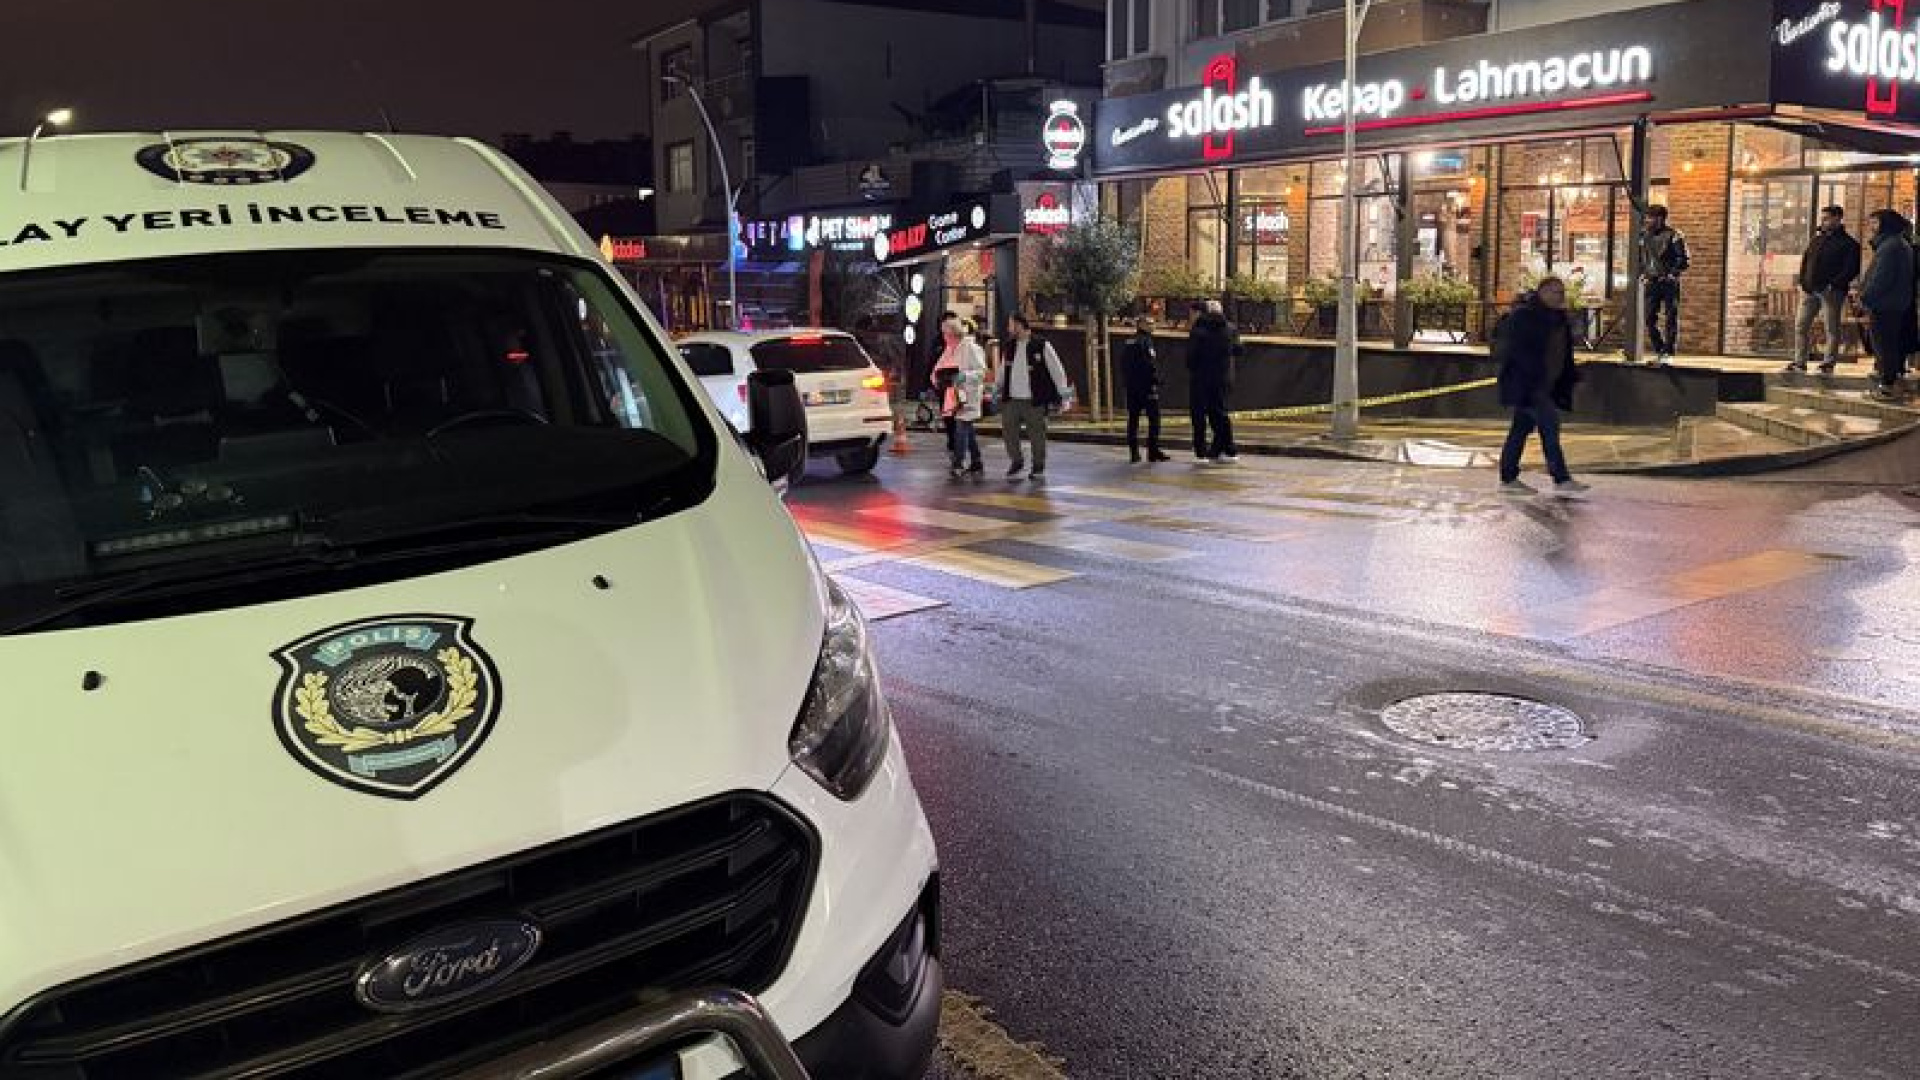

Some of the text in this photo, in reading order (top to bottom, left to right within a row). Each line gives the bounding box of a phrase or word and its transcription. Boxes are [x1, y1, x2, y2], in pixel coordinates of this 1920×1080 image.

[1827, 11, 1920, 81] salas
[1166, 76, 1272, 138] salash
[1303, 79, 1402, 121] Kebap
[1434, 45, 1652, 104] Lahmacun
[0, 203, 506, 246] AY YERİ İNCELEME
[403, 937, 501, 997] Ford
